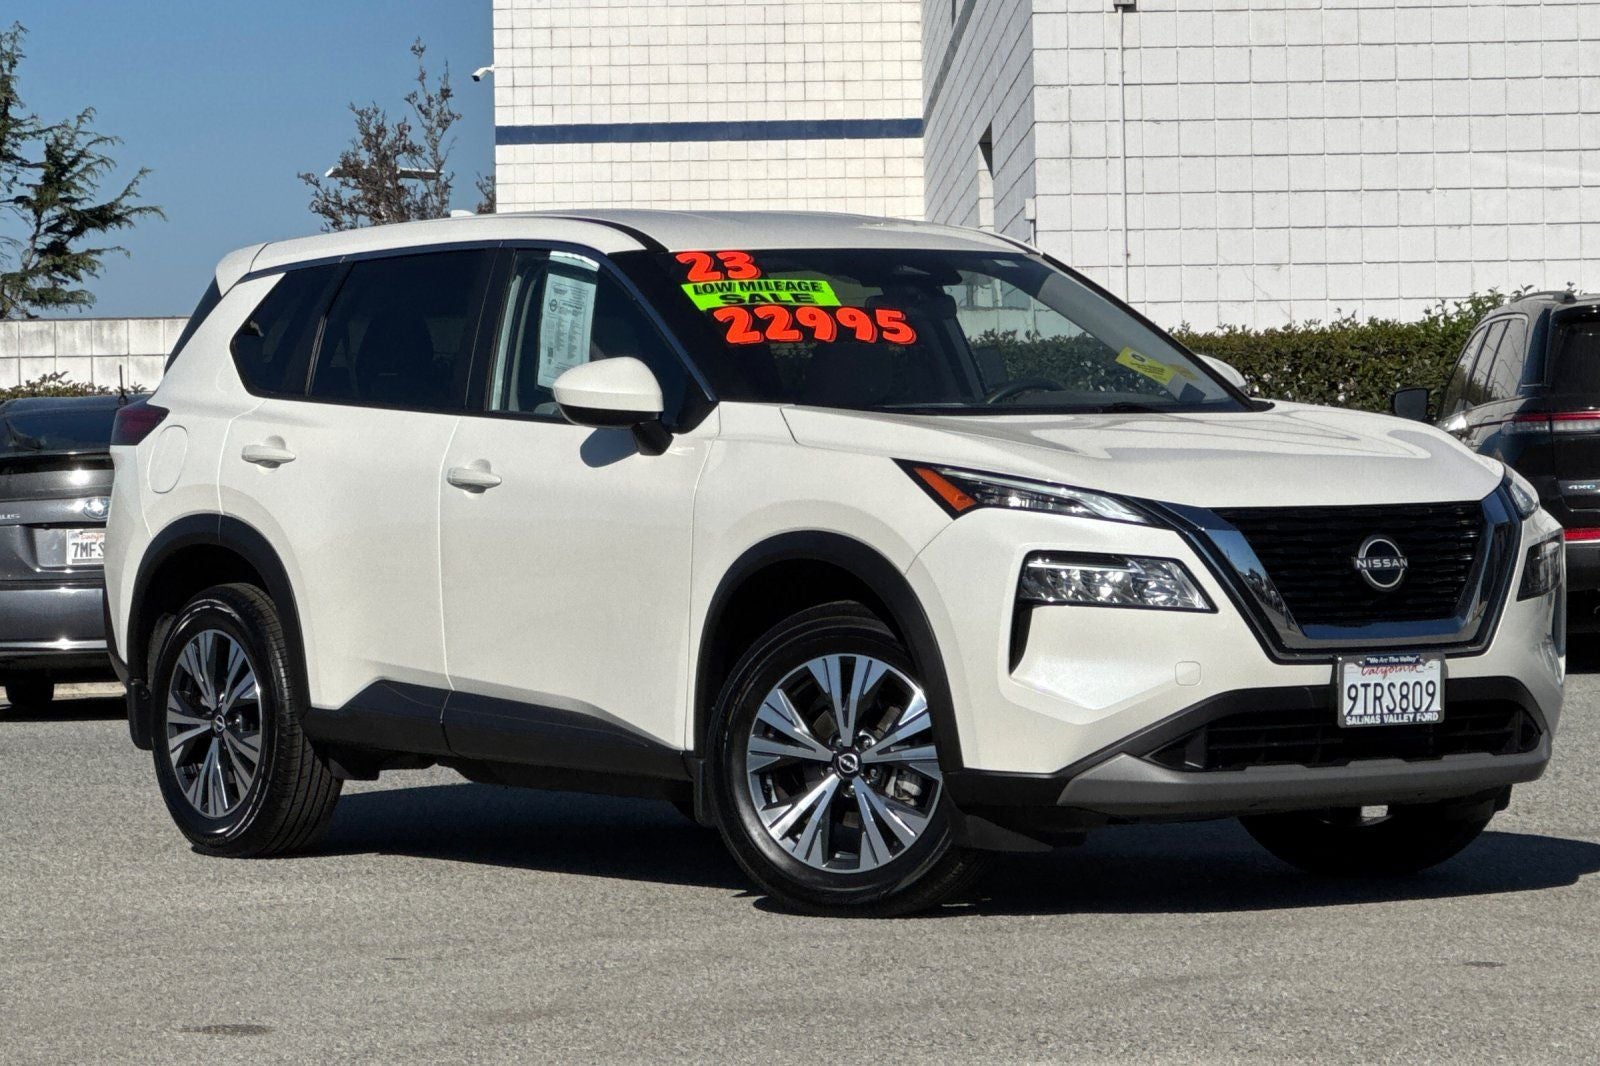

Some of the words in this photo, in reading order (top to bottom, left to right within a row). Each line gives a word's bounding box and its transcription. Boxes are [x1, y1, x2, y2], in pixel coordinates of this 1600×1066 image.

[676, 251, 761, 282] 23
[693, 281, 736, 296] LOW
[739, 280, 823, 293] MILEAGE
[719, 293, 819, 305] SALE
[713, 306, 916, 344] 22995
[1356, 558, 1408, 568] NISSAN
[1361, 664, 1424, 680] California
[1347, 680, 1436, 715] 9TRS809
[1346, 714, 1381, 725] SALINAS
[1383, 713, 1414, 723] VALLEY
[1416, 712, 1439, 722] FORD
